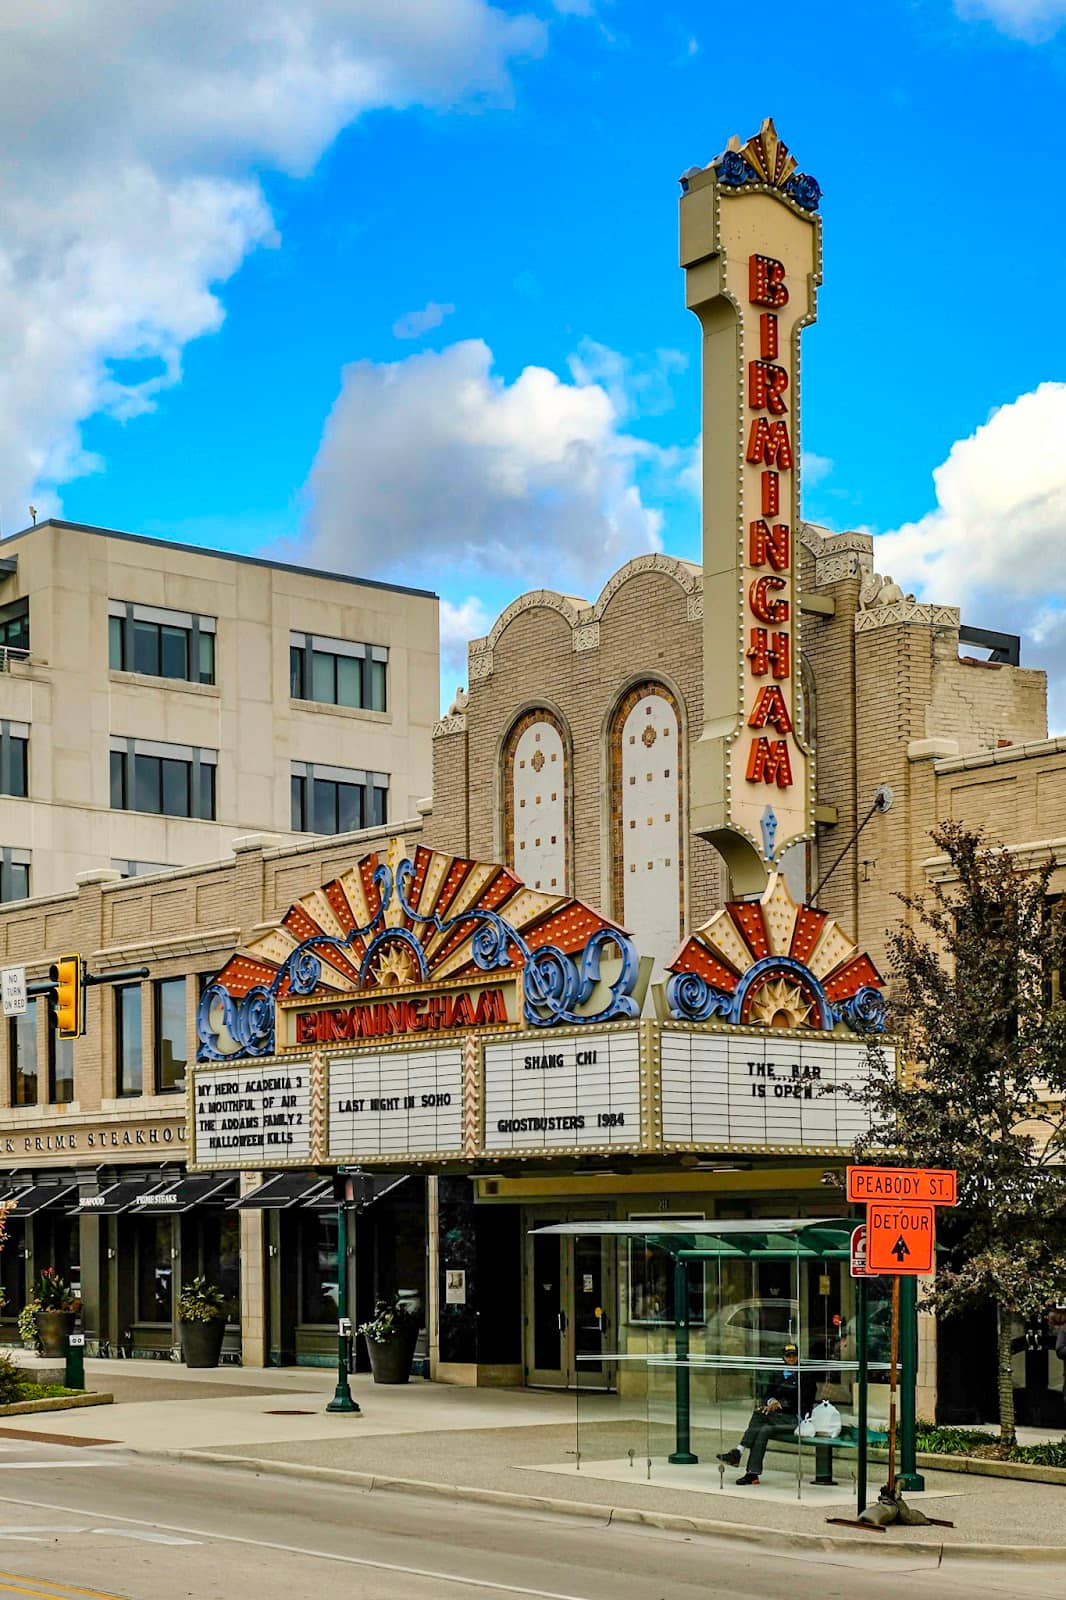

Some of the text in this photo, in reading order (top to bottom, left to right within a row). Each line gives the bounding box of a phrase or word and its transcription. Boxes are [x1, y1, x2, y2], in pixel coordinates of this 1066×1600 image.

[746, 253, 794, 789] BIRMINGHAM
[296, 988, 508, 1044] BIRMINGHAM
[524, 1050, 597, 1070] SHANG CHI
[747, 1062, 821, 1079] THE BAR
[198, 1076, 302, 1097] MY HERO ACADEMIA 3
[752, 1083, 813, 1099] IS OPEN
[199, 1095, 297, 1114] A MOUTHFUL OF AIR
[338, 1093, 451, 1113] LAST NIGHT IN SOHO
[200, 1113, 303, 1132] THE ADDAMS FAMILY 2
[497, 1112, 625, 1133] GHOSTBUSTERS 1984
[24, 1135, 77, 1151] PRIME
[209, 1132, 293, 1149] HALLOWEEN KILLS
[856, 1176, 920, 1195] PEABODY
[929, 1179, 949, 1197] ST.
[873, 1214, 929, 1230] DETOUR
